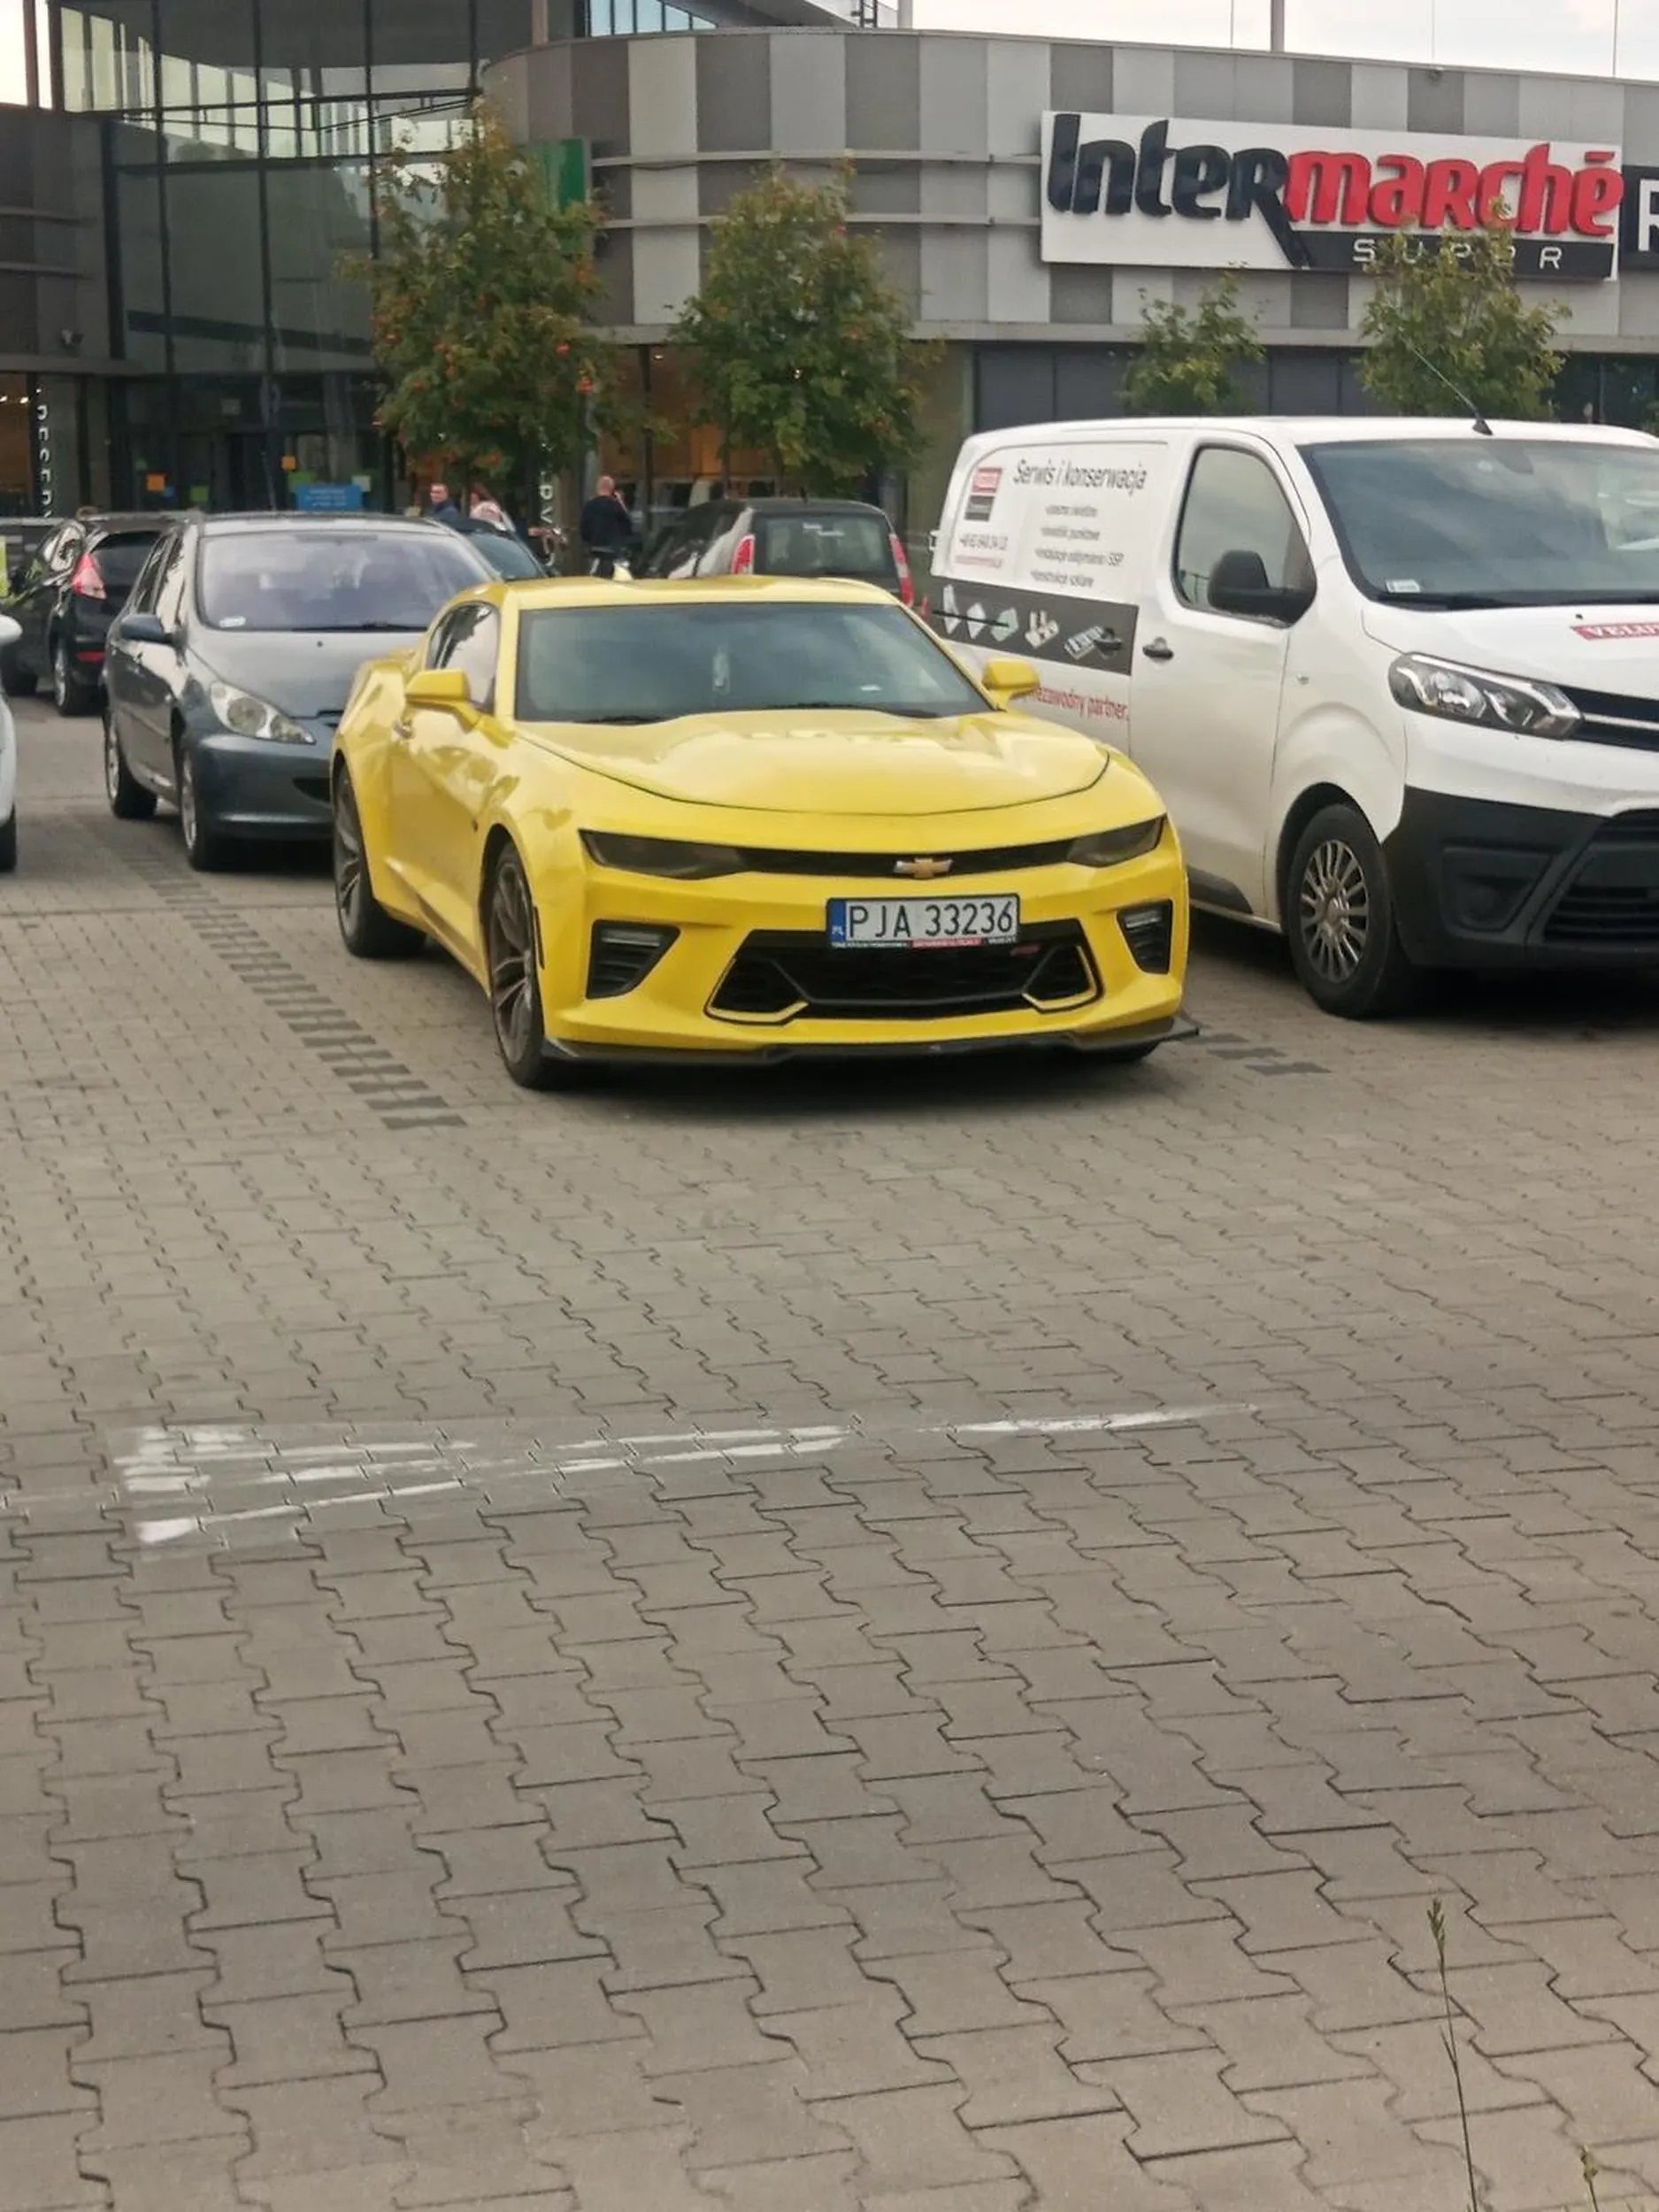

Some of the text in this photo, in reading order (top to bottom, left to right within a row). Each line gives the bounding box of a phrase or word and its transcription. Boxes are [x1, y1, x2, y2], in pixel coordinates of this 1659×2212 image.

[1012, 458, 1056, 484] Serwis
[1064, 459, 1147, 496] konserwacja
[849, 901, 1014, 938] PJA 33236
